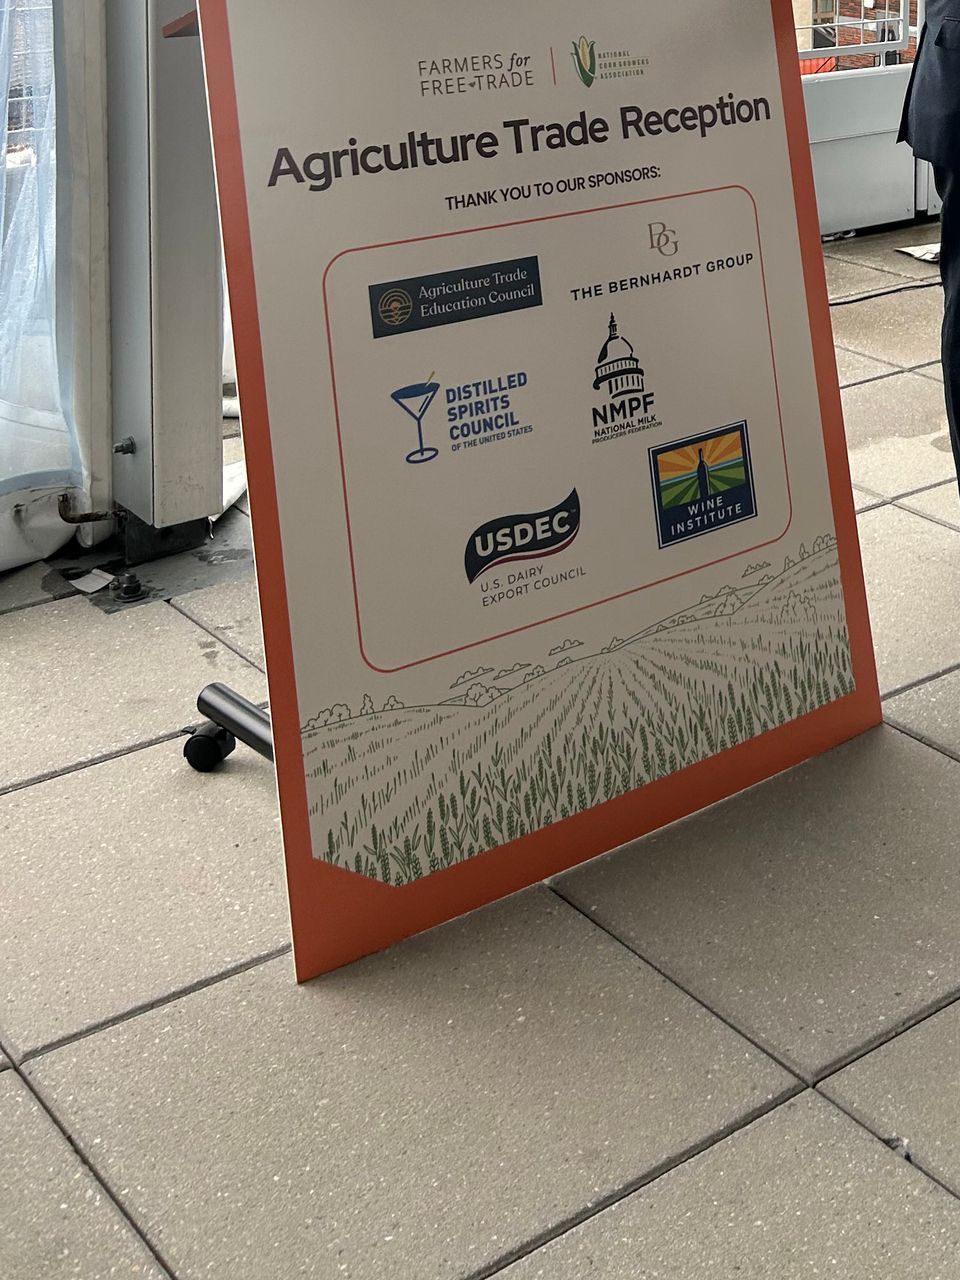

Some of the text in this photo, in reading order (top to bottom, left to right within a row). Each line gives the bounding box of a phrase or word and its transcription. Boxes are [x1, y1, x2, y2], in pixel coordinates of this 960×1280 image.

[418, 53, 531, 76] FARMERS for
[598, 50, 630, 59] NATIONAL
[420, 70, 534, 97] FREE TRADE
[600, 69, 644, 80] ASSOCIATION
[267, 92, 771, 192] Agriculture Trade Reception
[445, 165, 661, 210] THANK YOU TO OUR SPONSORS:
[418, 267, 528, 300] Agriculture Trade
[570, 253, 753, 301] THE BERNHARDT GROUP
[420, 283, 535, 318] Education Council
[446, 372, 528, 404] DISTILLED
[447, 394, 510, 422] SPIRITS
[592, 392, 655, 427] NMPF
[449, 412, 520, 440] COUNCIL
[451, 425, 533, 452] OF THE UNITED STATES
[592, 421, 663, 444] PRODUCERS FEDERATION
[594, 414, 657, 437] NATIONAL MILK
[671, 503, 742, 536] INSTITUTE
[688, 496, 723, 516] WINE
[475, 511, 571, 557] USDEC
[481, 565, 544, 593] U.S. DAIRY
[482, 566, 587, 607] EXPORT COUNCIL
